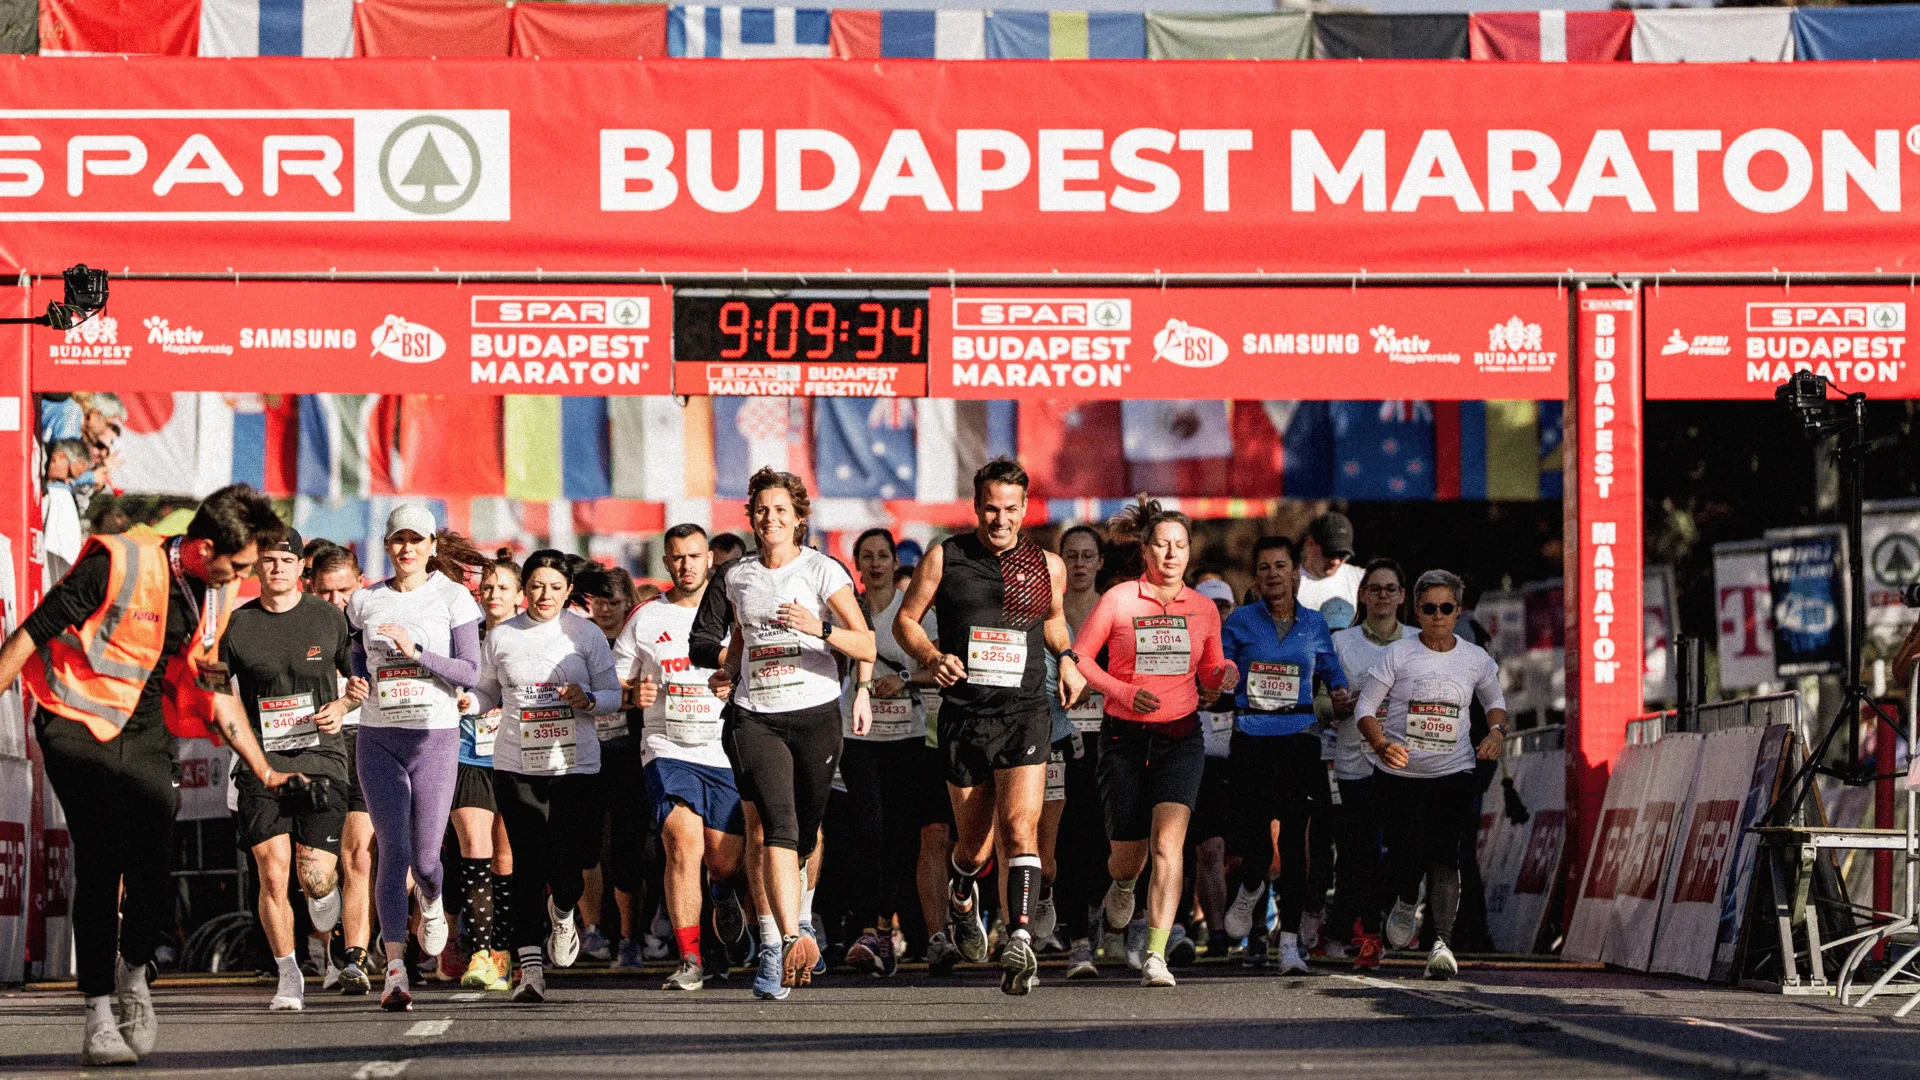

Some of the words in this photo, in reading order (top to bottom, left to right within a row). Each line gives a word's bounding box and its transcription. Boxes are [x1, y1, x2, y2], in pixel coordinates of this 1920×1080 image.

[0, 134, 344, 198] SPAR
[600, 127, 1253, 213] BUDAPEST
[498, 302, 606, 322] SPAR
[980, 304, 1087, 324] SPAR
[1771, 308, 1866, 326] SPAR
[147, 325, 204, 344] Aktiv
[240, 328, 356, 349] SAMSUNG
[718, 302, 923, 361] 9:09:34
[402, 333, 431, 357] BSI
[471, 334, 650, 359] BUDAPEST
[952, 336, 1131, 361] BUDAPEST
[1184, 338, 1213, 361] BSI
[1242, 333, 1360, 355] SAMSUNG
[1374, 334, 1430, 354] Aktiv
[1747, 337, 1906, 359] BUDAPEST
[50, 345, 132, 359] BUDAPEST
[1474, 352, 1557, 366] BUDAPEST
[808, 367, 898, 381] BUDAPEST
[804, 379, 897, 396] FESZTIVÁL
[1593, 313, 1615, 499] BUDAPEST
[1144, 619, 1173, 627] SPAR
[981, 632, 1014, 642] SPAR
[1152, 635, 1182, 644] 31014
[756, 648, 785, 657] SPAR
[981, 651, 1020, 663] 32558
[386, 669, 416, 677] SPAR
[759, 664, 796, 678] 32559
[1258, 665, 1287, 674] SPAR
[391, 687, 425, 698] 31857
[1260, 680, 1293, 691] 31093
[268, 700, 298, 709] SPAR
[678, 704, 711, 713] 30108
[872, 705, 907, 715] 33433
[1418, 706, 1446, 714] SPAR
[528, 710, 560, 719] SPAR
[272, 715, 310, 729] 34093
[1420, 721, 1453, 733] 30199
[533, 727, 569, 739] 33155
